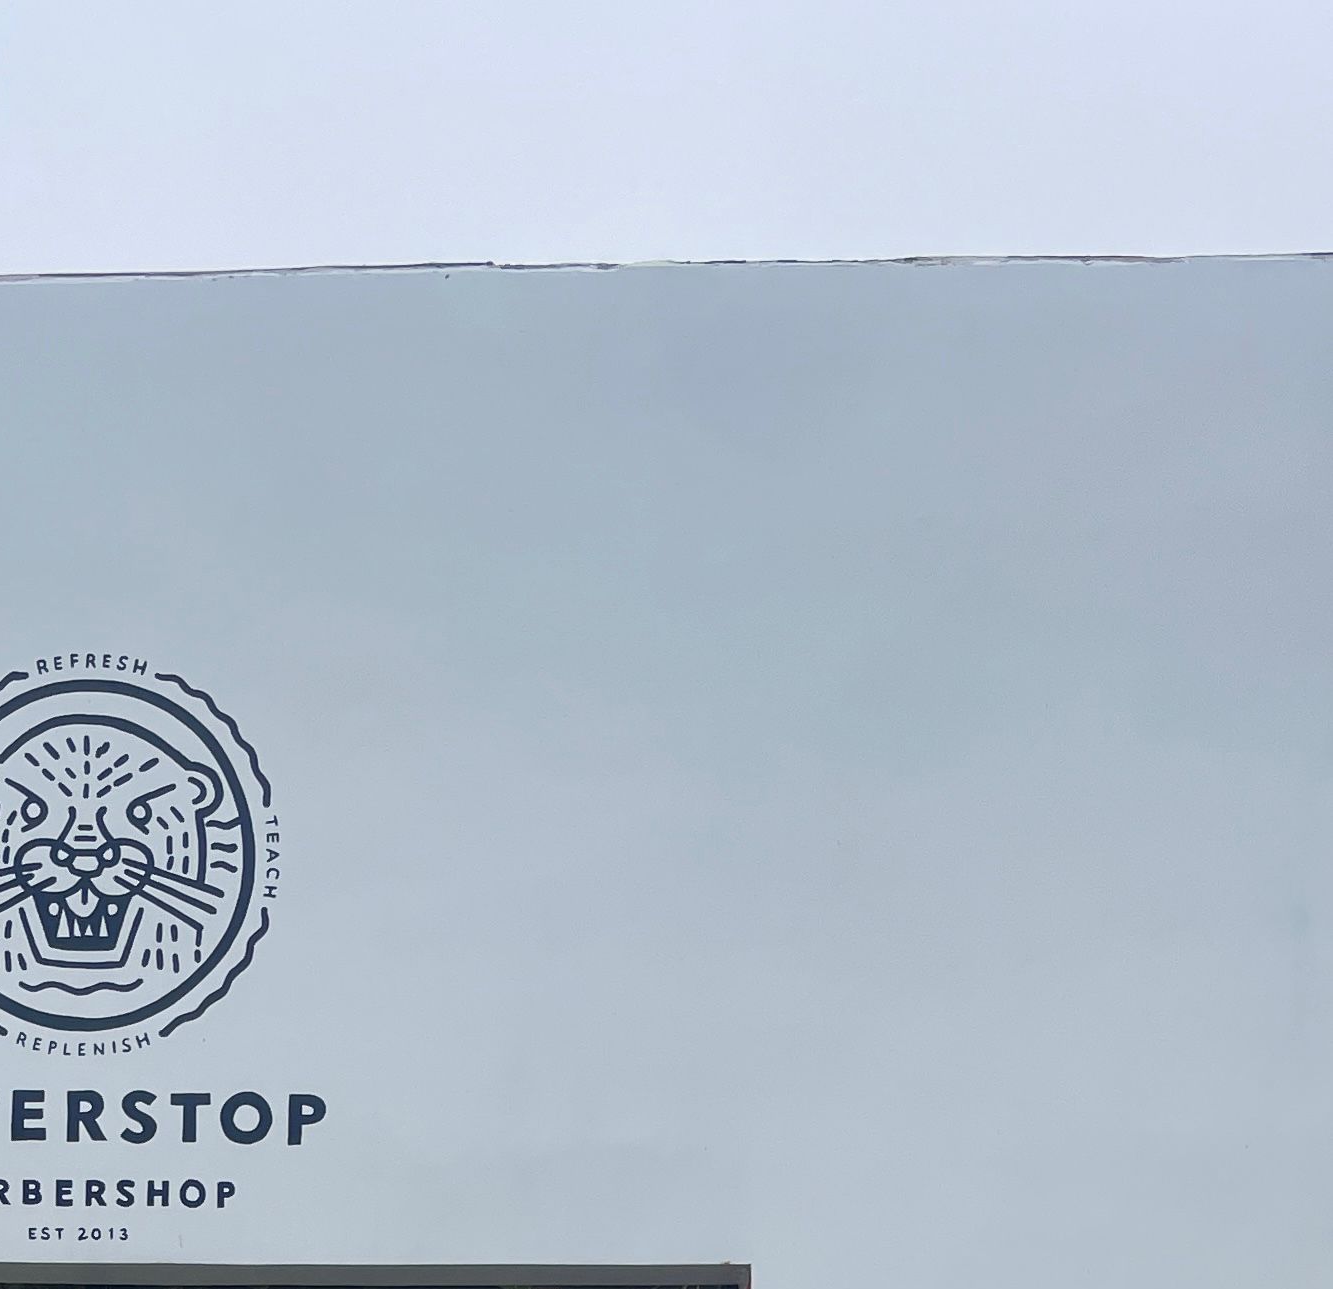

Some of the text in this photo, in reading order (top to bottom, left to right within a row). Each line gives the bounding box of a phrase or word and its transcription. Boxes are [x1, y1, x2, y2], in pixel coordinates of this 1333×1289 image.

[36, 653, 148, 676] REFRESH
[263, 815, 279, 899] TEACH
[16, 1030, 151, 1057] REPLENISH
[28, 1227, 129, 1241] EST 2013
